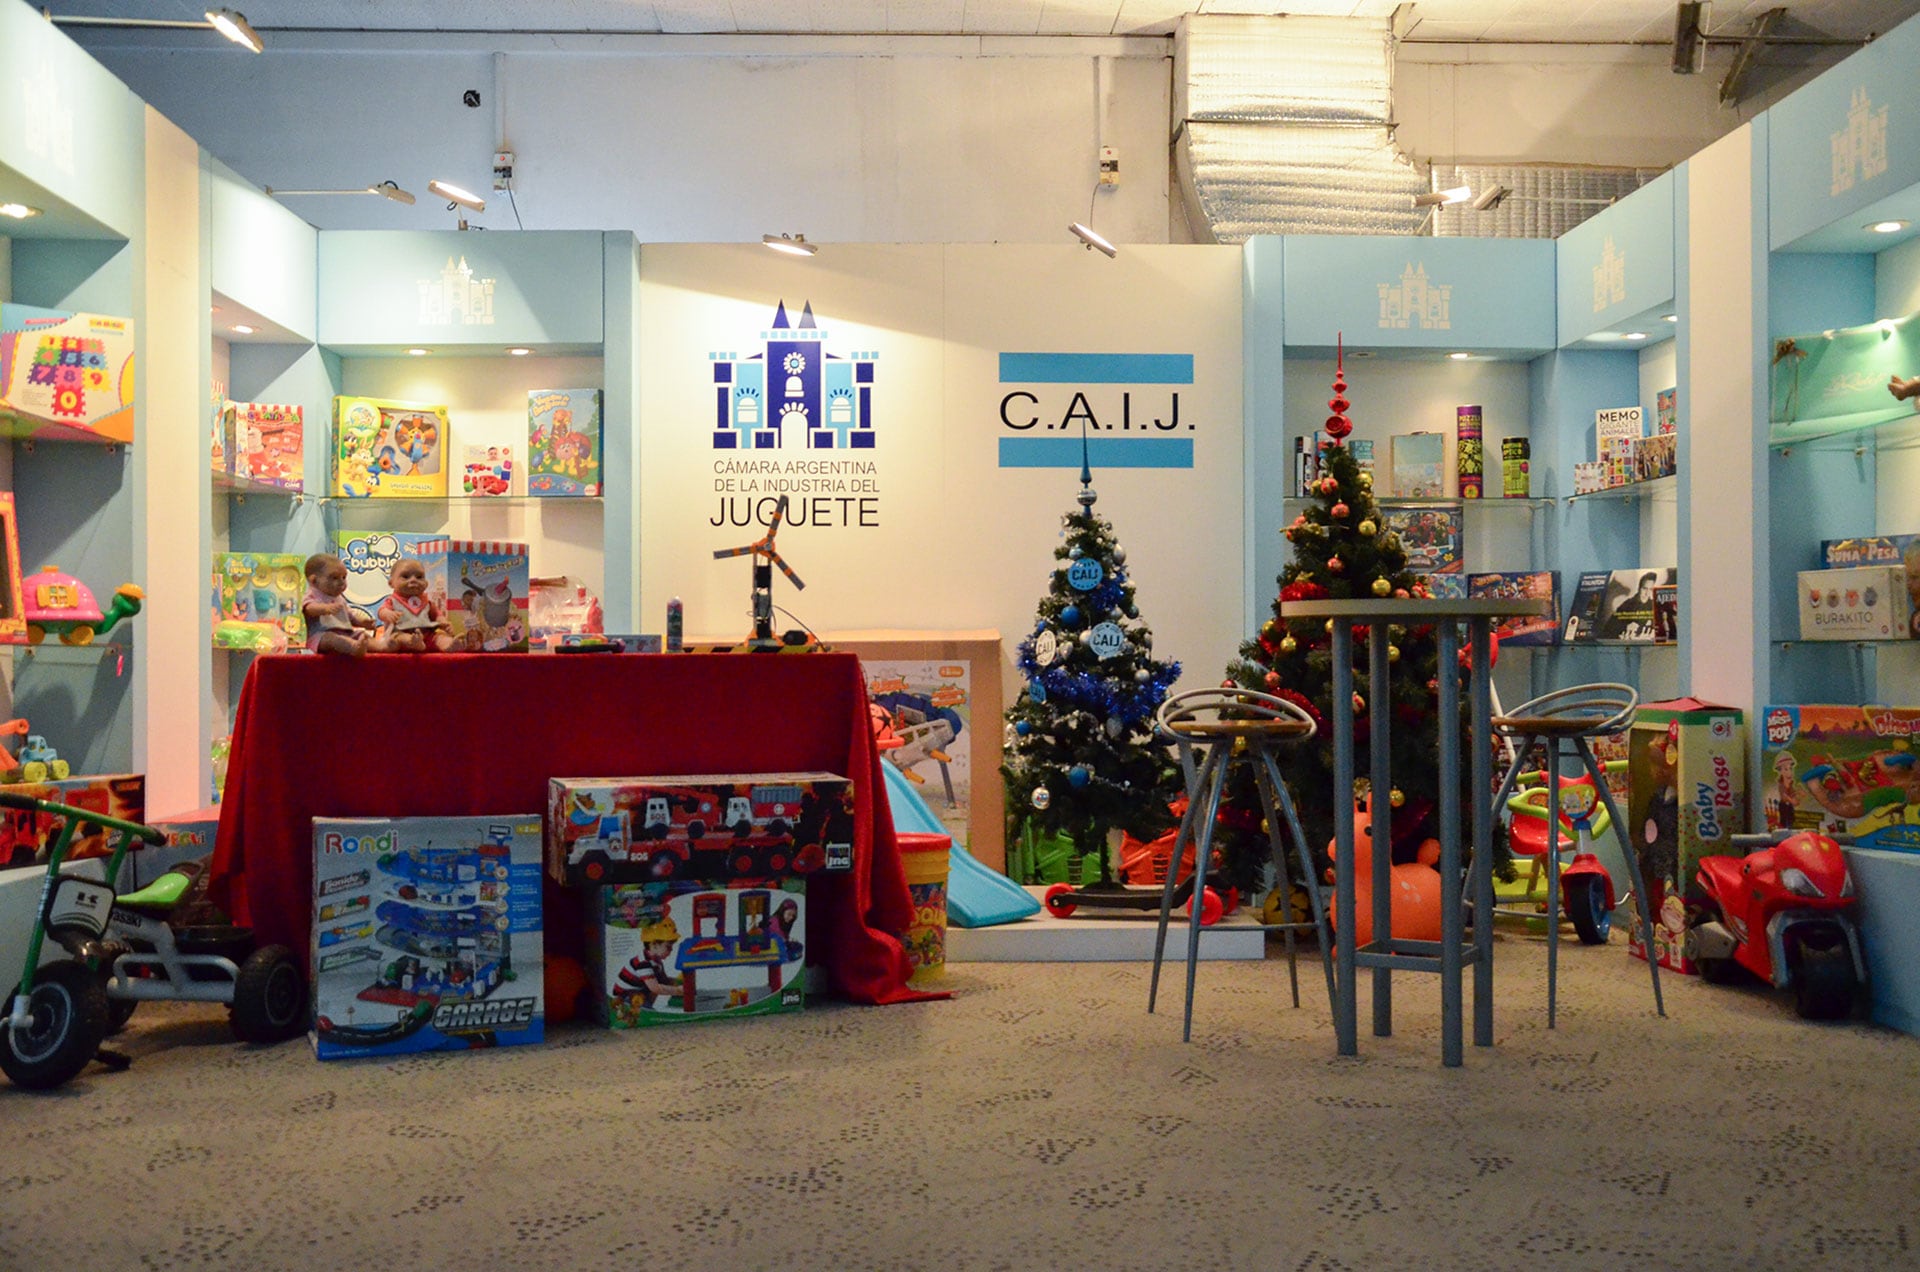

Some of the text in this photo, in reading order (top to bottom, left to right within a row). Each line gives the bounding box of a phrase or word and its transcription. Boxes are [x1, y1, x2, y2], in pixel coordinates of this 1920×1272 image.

[89, 355, 100, 366] 6
[36, 365, 103, 385] 7 8 9
[999, 391, 1196, 431] C.A.I.J.
[1599, 410, 1640, 422] MEMO
[713, 457, 878, 475] CÁMARA ARGENTINA
[714, 479, 880, 493] DE LA INDUSTRIA DEL
[709, 496, 880, 528] JUGUETE
[1867, 542, 1900, 561] PESA
[1071, 568, 1099, 581] CAIJ
[1815, 611, 1873, 625] BURAKITO
[1093, 634, 1121, 647] CAIJ
[1768, 725, 1792, 742] POP
[1713, 756, 1733, 808] Rose
[1695, 781, 1721, 838] Baby
[325, 828, 399, 854] Rondi
[631, 852, 649, 862] SOS
[433, 998, 534, 1028] GARAGE
